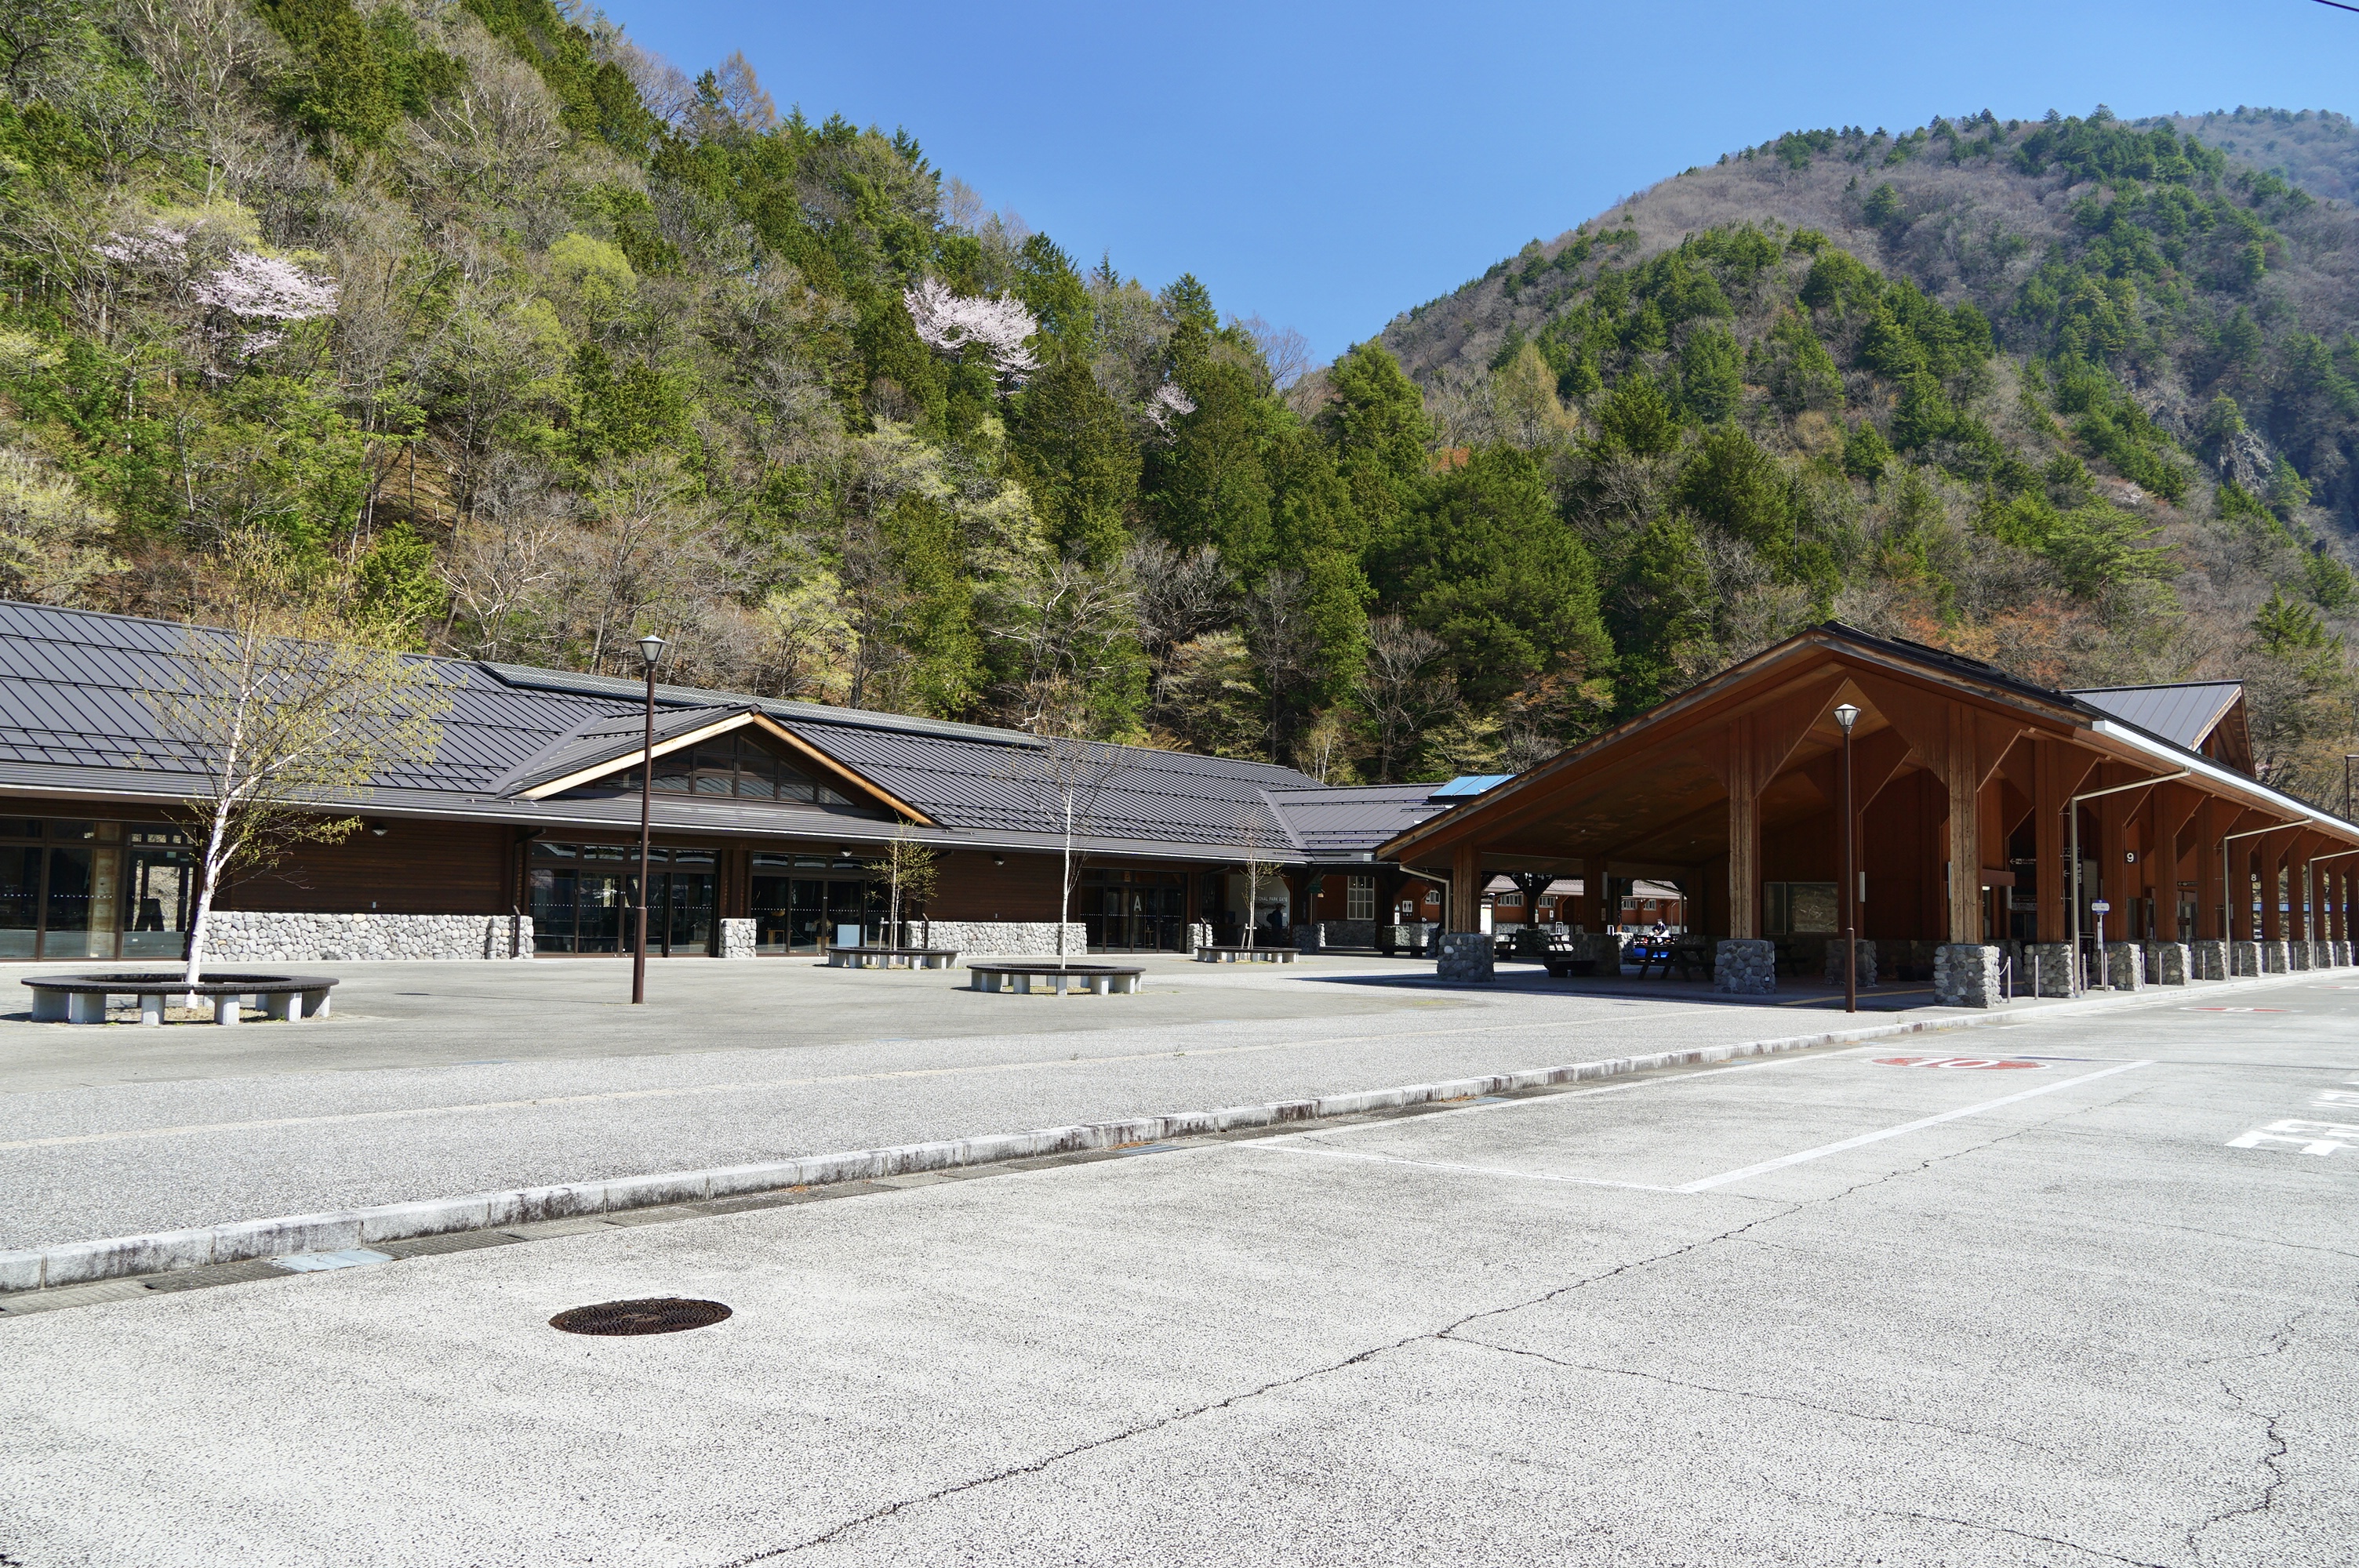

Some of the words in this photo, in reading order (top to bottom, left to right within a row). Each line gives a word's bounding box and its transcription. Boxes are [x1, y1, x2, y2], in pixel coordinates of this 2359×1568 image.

[2127, 852, 2135, 862] 9
[1133, 895, 1142, 911] A
[1907, 1058, 2001, 1069] 10
